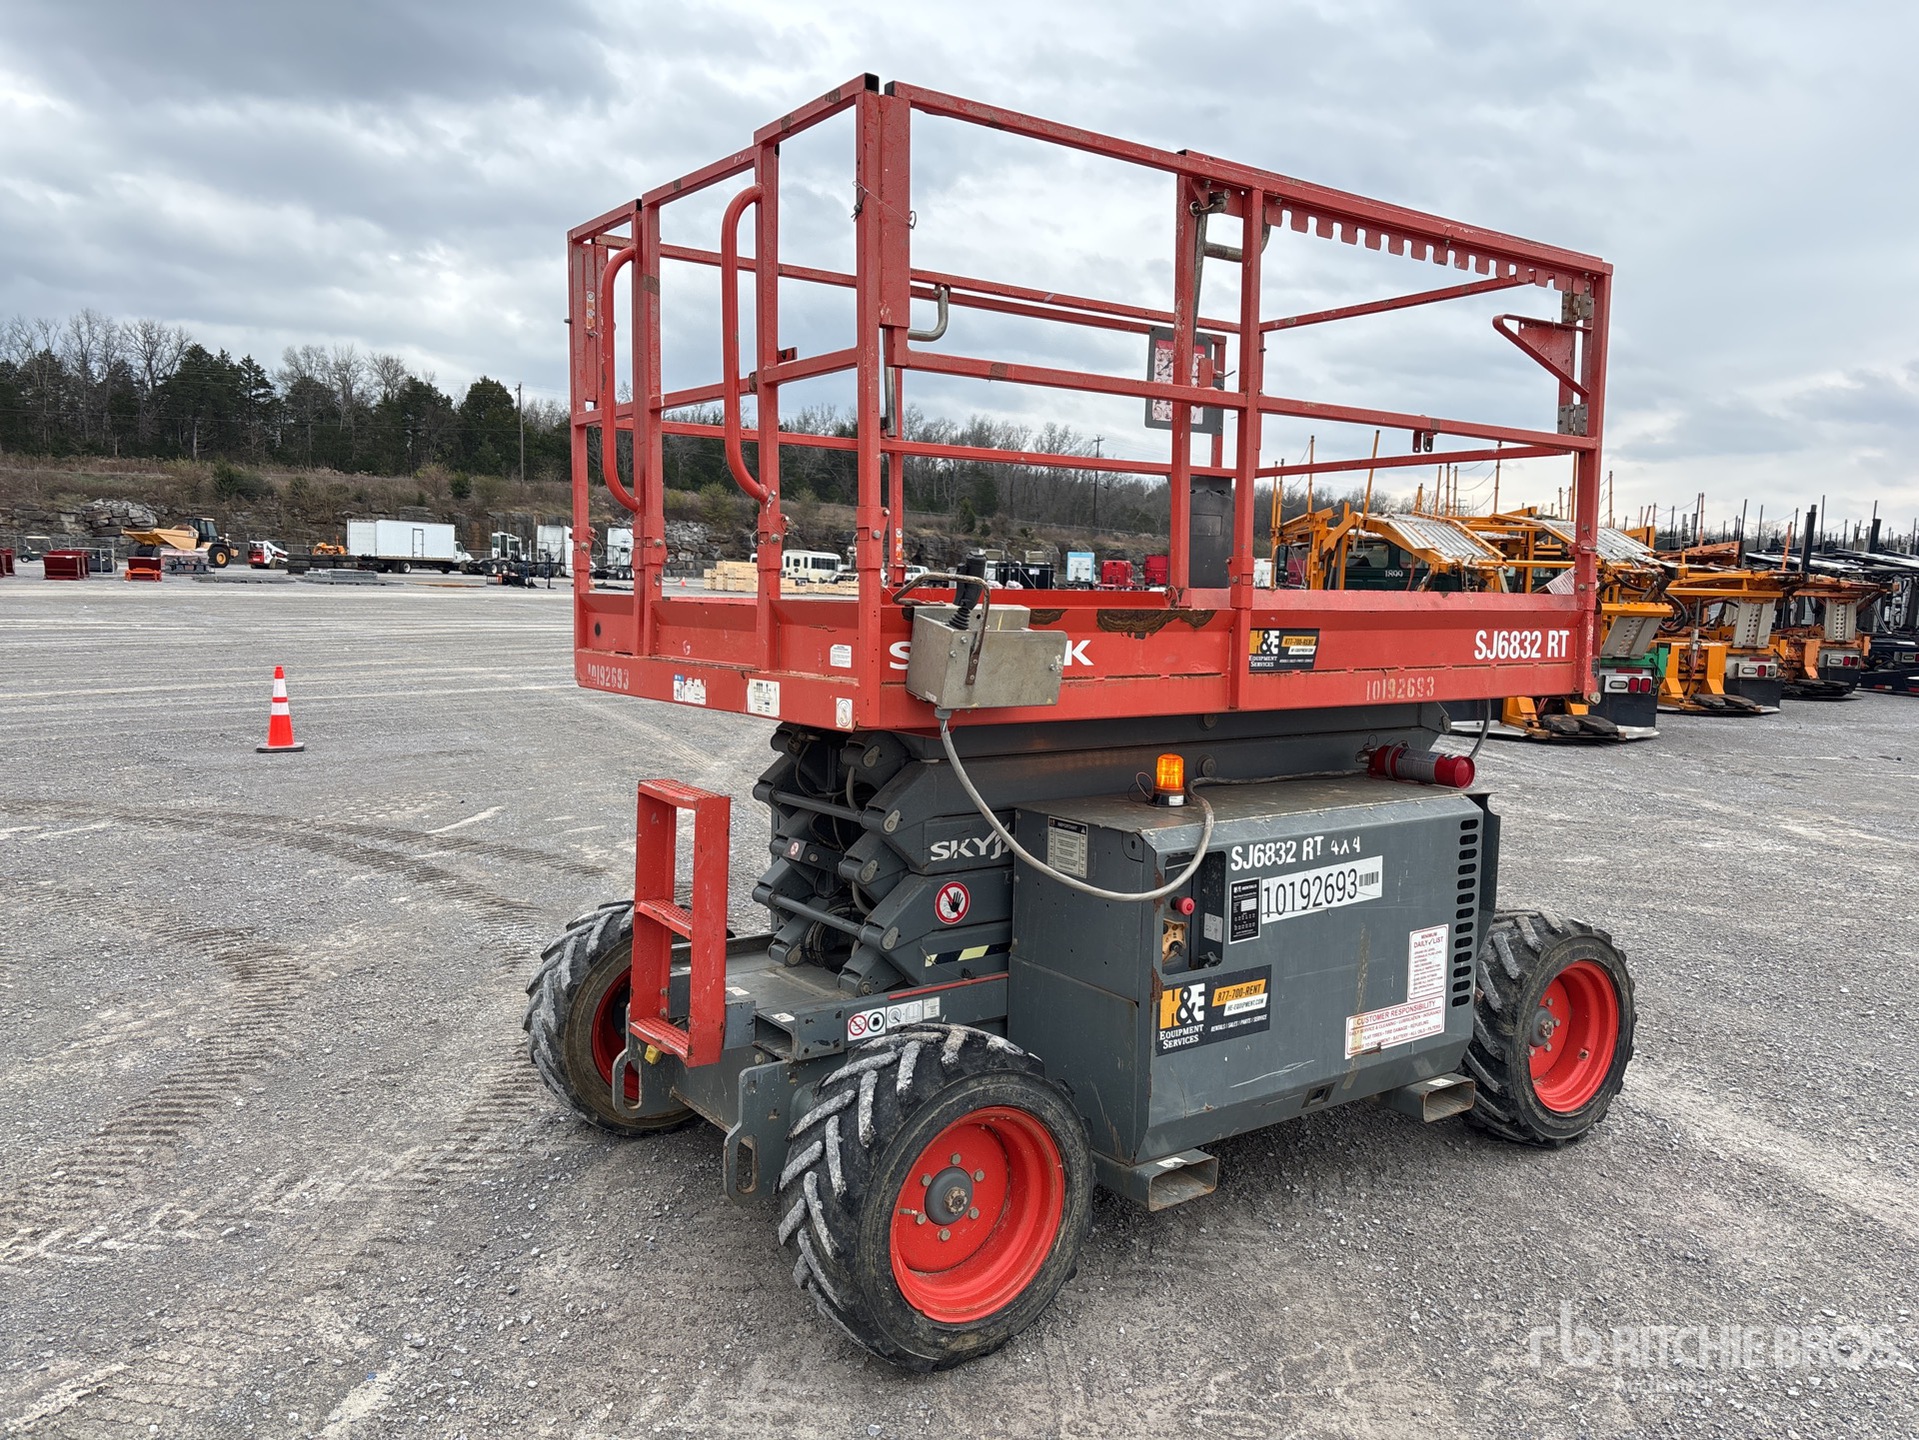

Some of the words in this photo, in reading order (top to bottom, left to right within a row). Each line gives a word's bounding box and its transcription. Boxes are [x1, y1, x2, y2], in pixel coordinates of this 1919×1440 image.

[1474, 629, 1542, 660] SJ6832
[1547, 630, 1570, 658] RT
[1366, 675, 1435, 701] 10192693
[1230, 840, 1297, 871] SJ6832
[1302, 835, 1325, 861] RT
[1264, 868, 1358, 918] 10192693
[1217, 983, 1262, 1002] 877-700-RENT
[1159, 983, 1206, 1030] H&E
[1356, 1011, 1391, 1026] CUSTOMER
[1390, 1000, 1436, 1017] RESPONSIBILITY
[1159, 1024, 1204, 1041] EQUIPMENT
[1162, 1034, 1200, 1050] SERVICES
